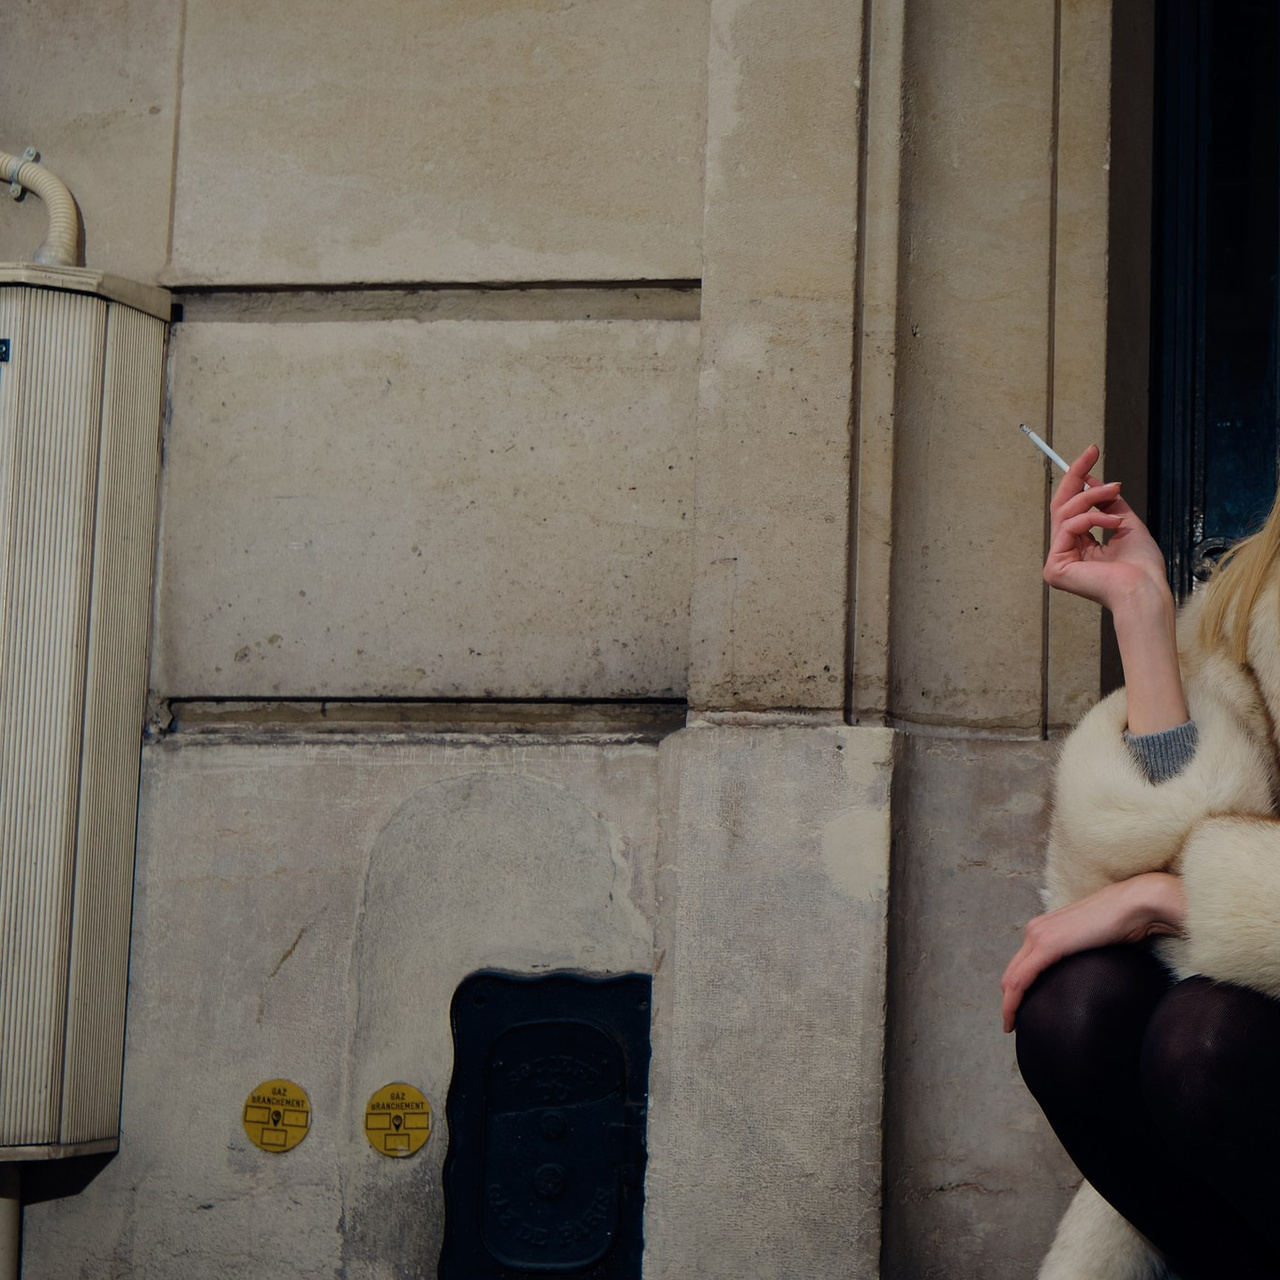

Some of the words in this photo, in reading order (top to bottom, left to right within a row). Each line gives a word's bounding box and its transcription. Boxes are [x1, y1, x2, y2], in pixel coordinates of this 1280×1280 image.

[271, 1087, 287, 1097] GAZ
[390, 1092, 405, 1101] GAZ
[252, 1095, 305, 1108] BRANCHEMENT
[371, 1101, 425, 1111] BRANCHEMENT
